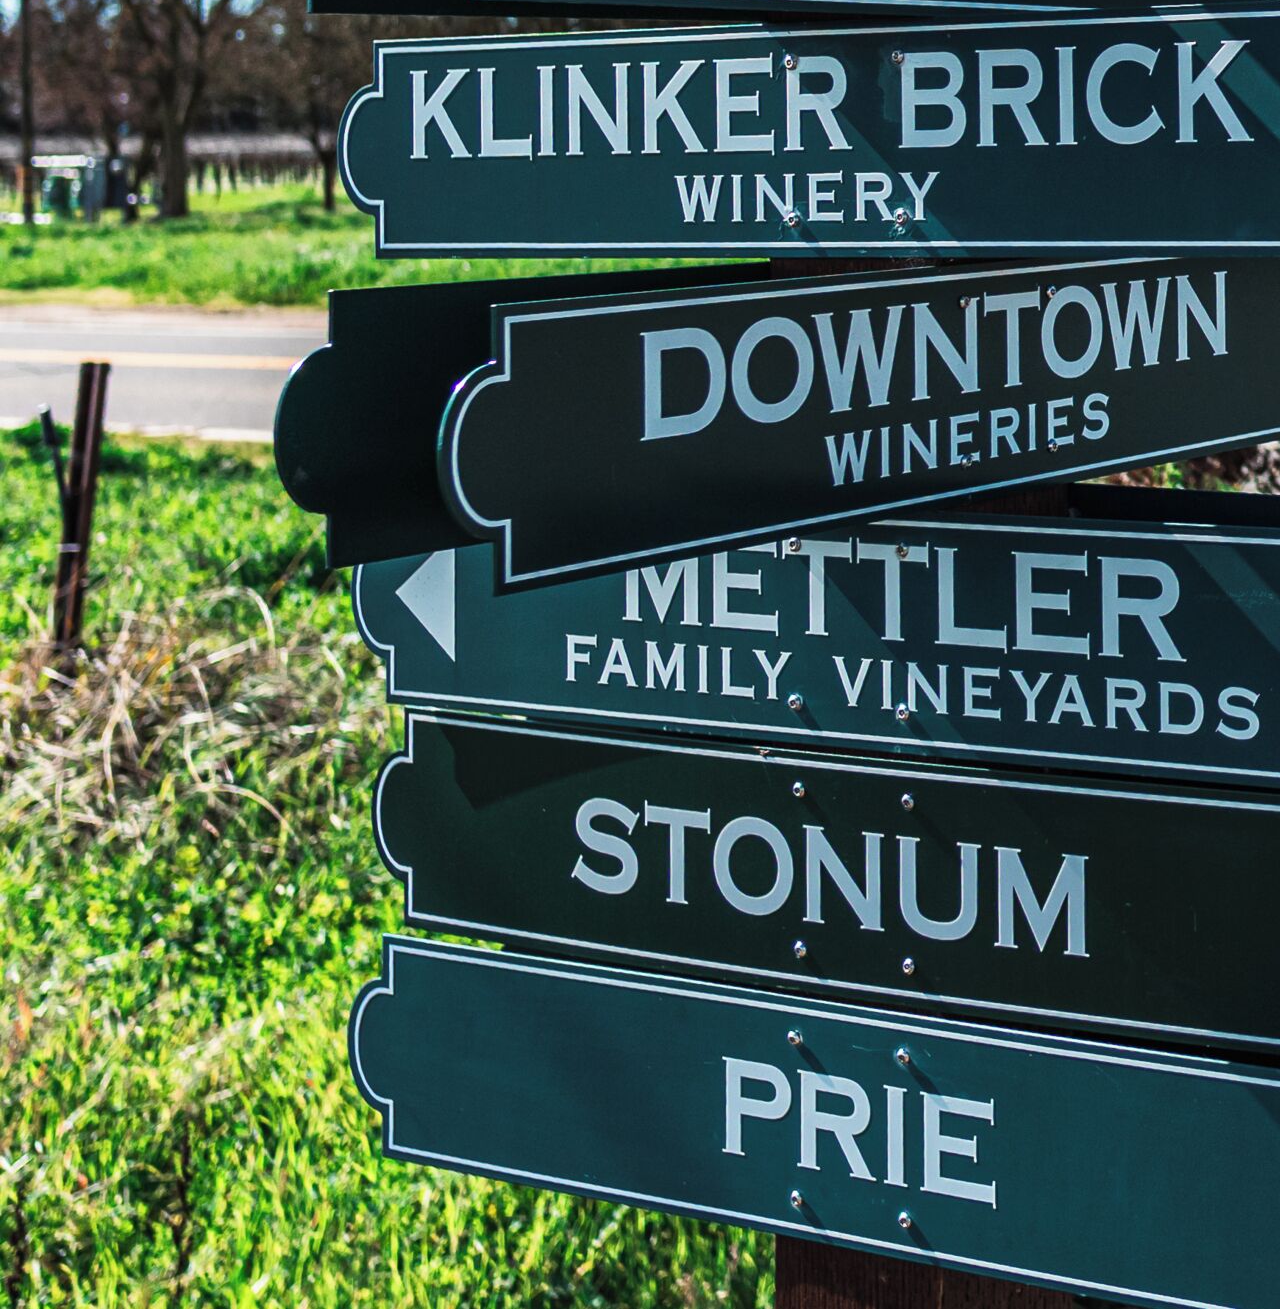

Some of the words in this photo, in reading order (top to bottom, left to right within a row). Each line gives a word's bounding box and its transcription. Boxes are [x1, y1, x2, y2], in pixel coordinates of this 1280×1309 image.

[409, 53, 852, 160] KLINKER
[899, 39, 1255, 150] BRICK
[673, 170, 941, 223] WINERY
[639, 270, 1229, 441] DOWNTOWN
[824, 393, 1111, 486] WINERIES
[622, 537, 1187, 662] METTLER
[566, 634, 793, 700] FAMILY
[833, 656, 1261, 740] VINEYARDS
[571, 797, 1090, 957] STONUM
[722, 1055, 996, 1209] PRIE
